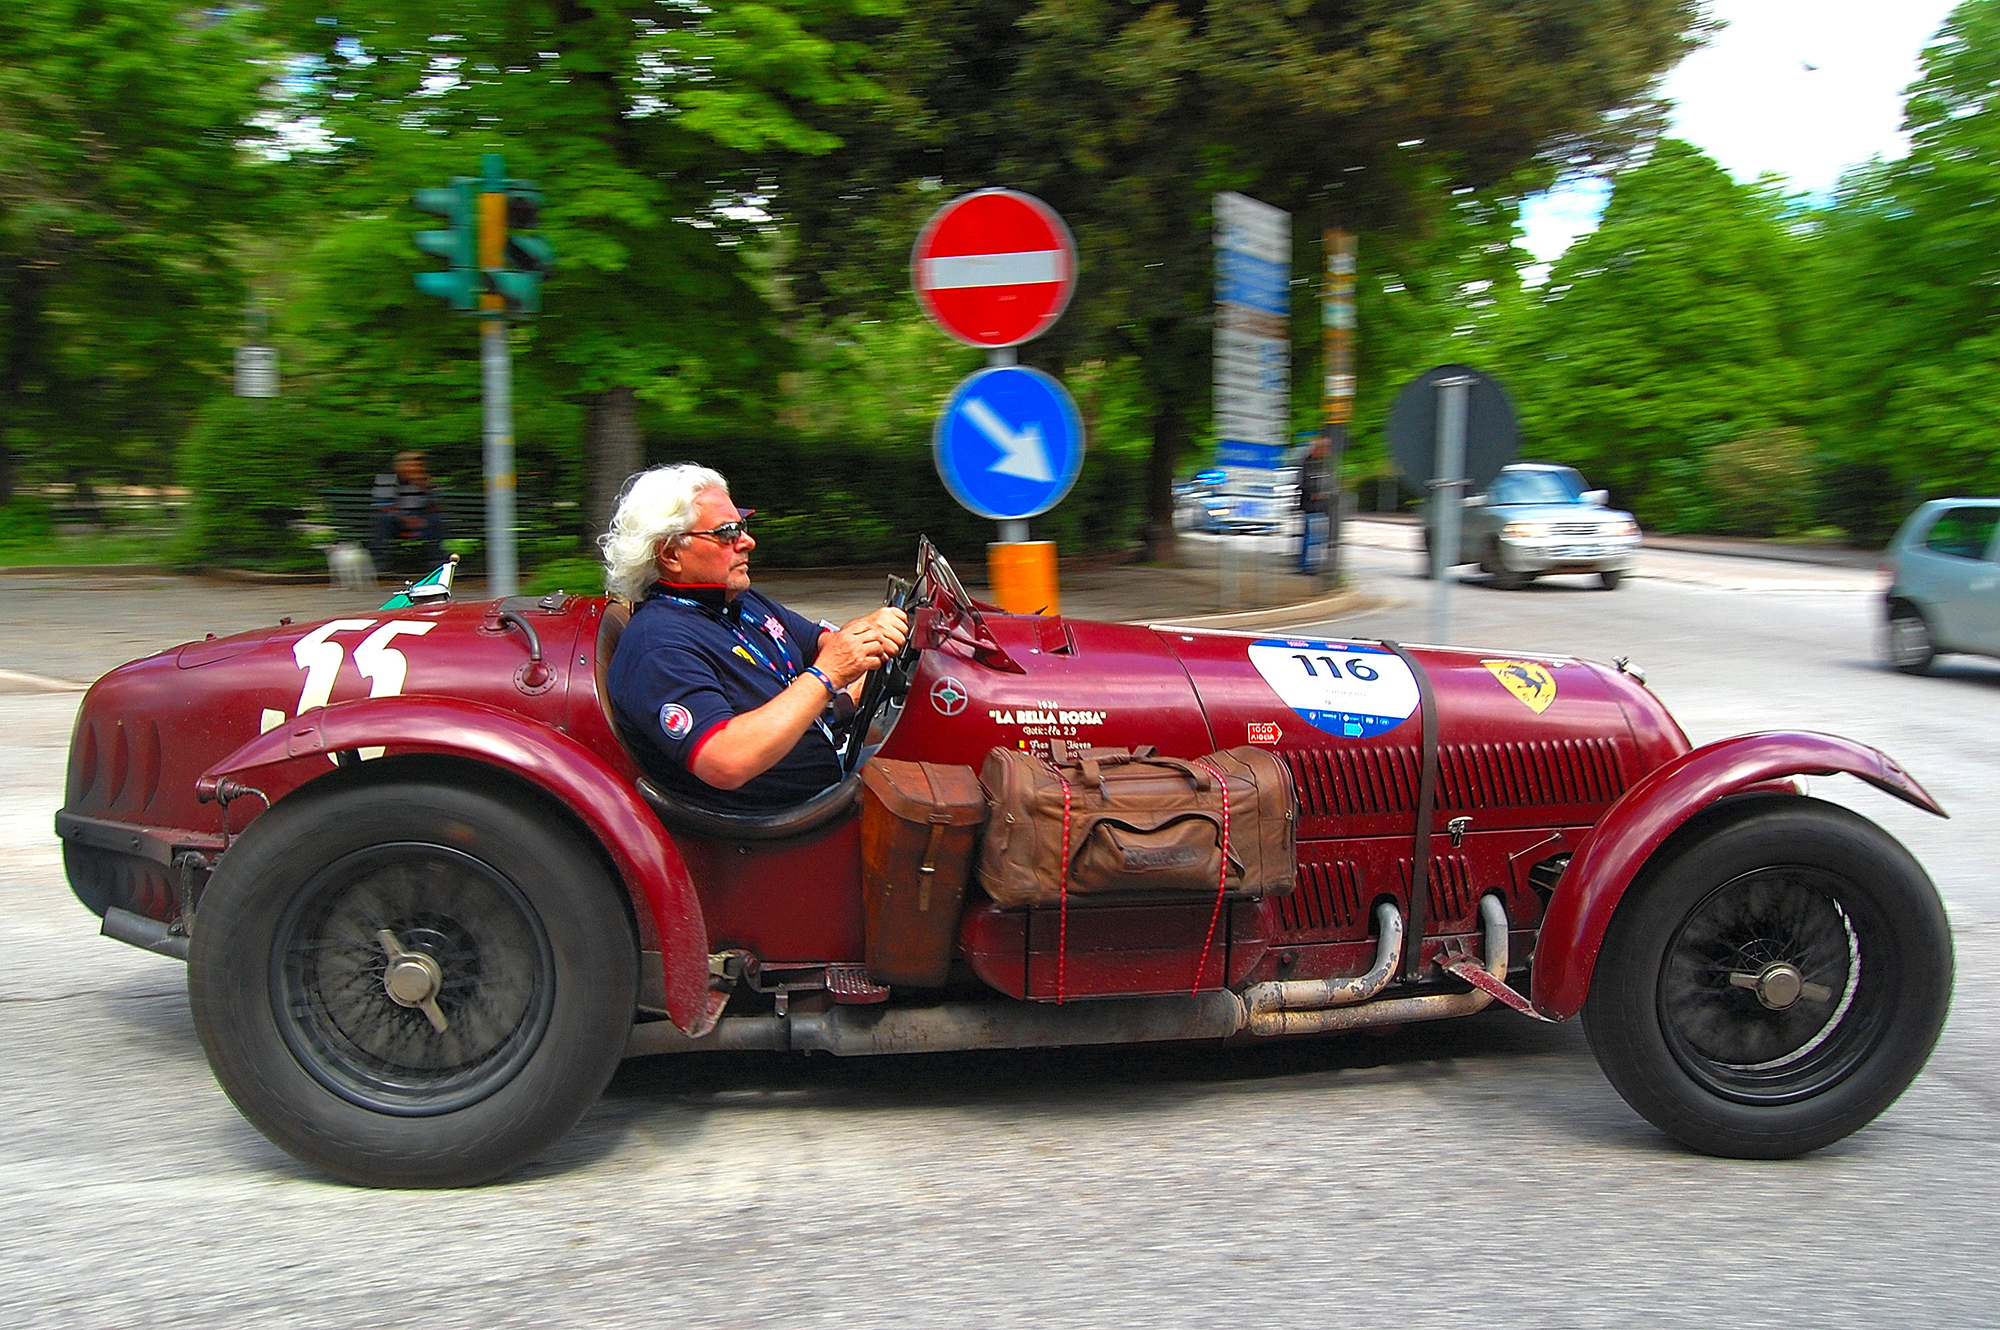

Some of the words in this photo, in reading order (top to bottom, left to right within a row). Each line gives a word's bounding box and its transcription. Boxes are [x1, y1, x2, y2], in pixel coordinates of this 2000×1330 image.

[1291, 654, 1380, 681] 116
[1016, 710, 1058, 724] BELLA
[1059, 711, 1107, 725] ROSSA"
[1252, 725, 1273, 733] 1000
